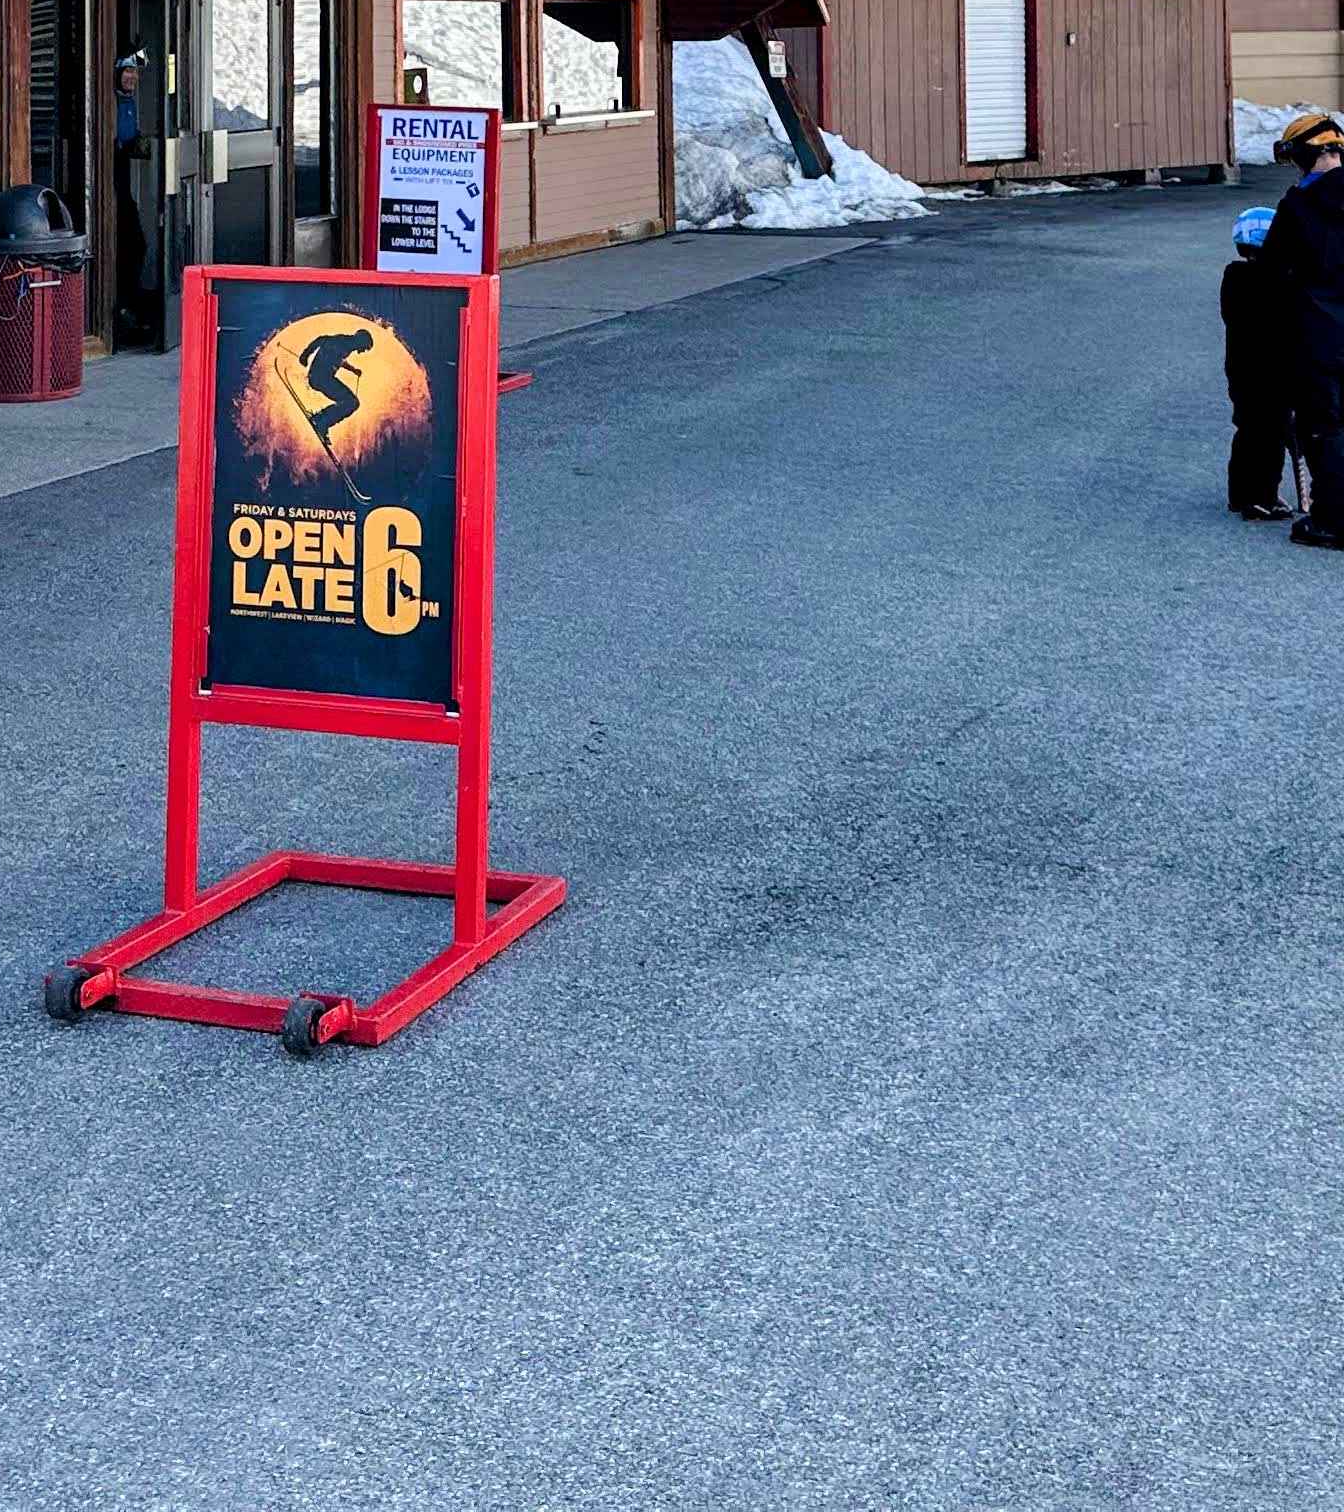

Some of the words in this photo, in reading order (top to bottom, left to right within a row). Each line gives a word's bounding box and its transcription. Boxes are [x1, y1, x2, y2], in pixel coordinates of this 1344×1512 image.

[392, 117, 479, 140] RENTAL
[392, 148, 476, 163] EQUIPMENT
[390, 166, 396, 175] &
[399, 167, 429, 176] LESSON
[431, 168, 473, 178] PACKAGES
[393, 204, 400, 212] IN
[402, 204, 413, 213] THE
[415, 205, 436, 214] LODGE
[381, 214, 400, 224] DOWN
[402, 215, 413, 224] THE
[414, 216, 436, 225] STAIRS
[411, 227, 421, 236] TO
[423, 228, 435, 236] THE
[391, 238, 414, 247] LOWER
[416, 239, 435, 248] LEVEL
[233, 503, 275, 516] FRIDAY
[277, 507, 286, 517] &
[288, 507, 356, 522] SATURDAYS
[228, 516, 355, 566] OPEN
[362, 506, 422, 635] 6
[422, 601, 439, 618] PM
[233, 560, 355, 614] LATE
[230, 608, 267, 618] NORTHWEST
